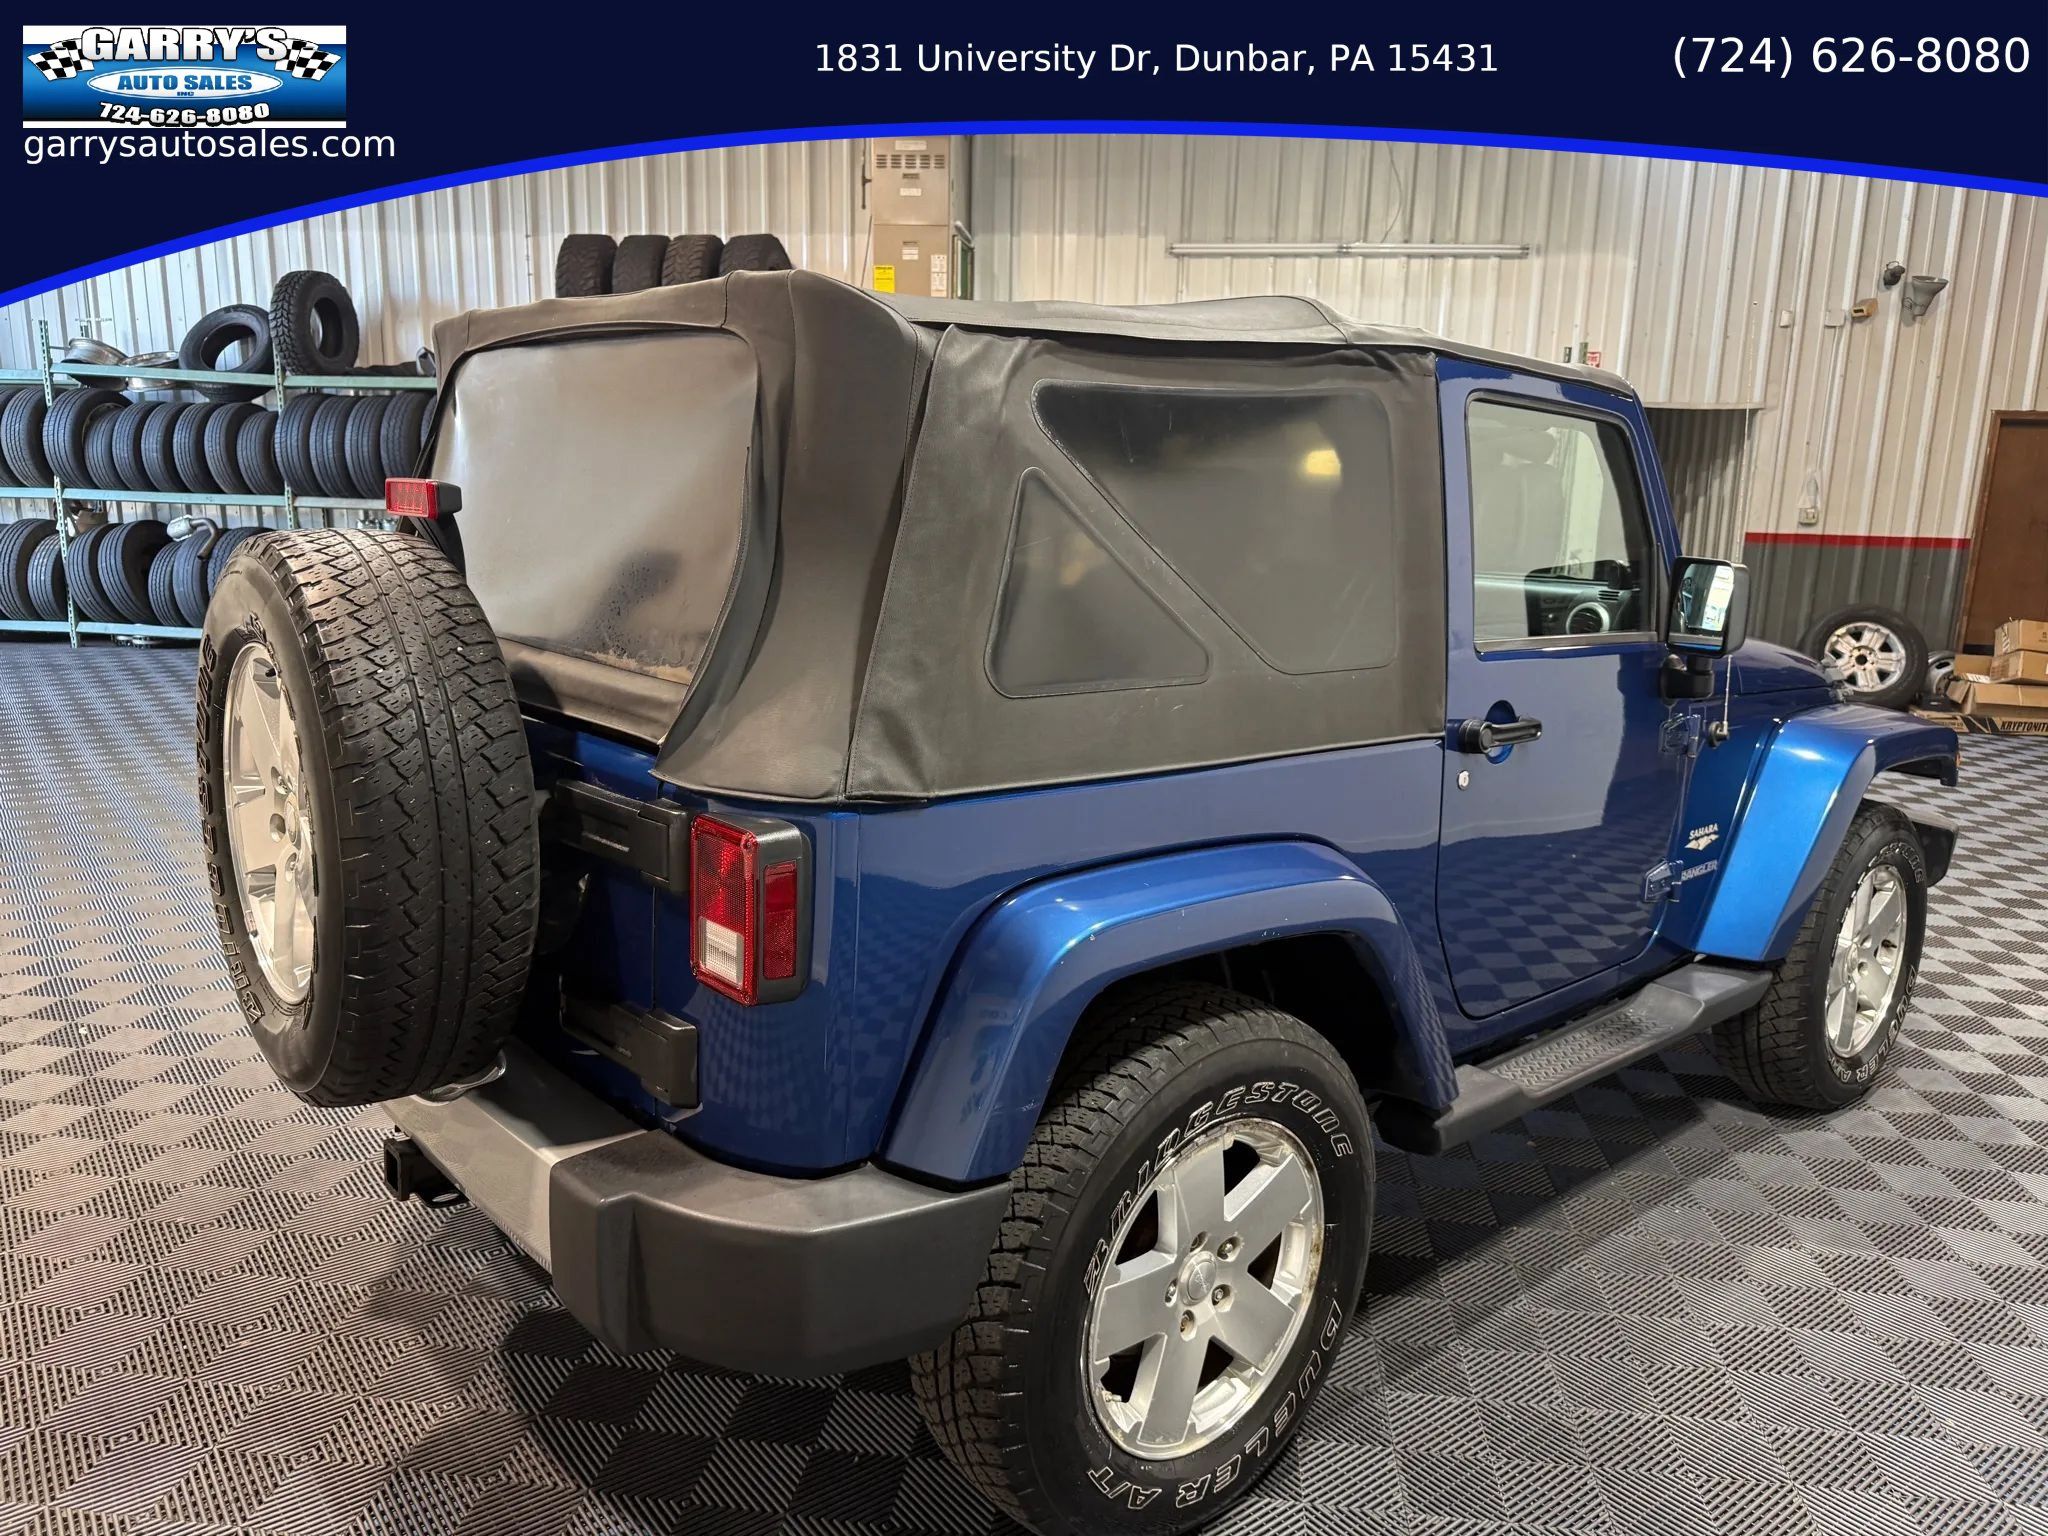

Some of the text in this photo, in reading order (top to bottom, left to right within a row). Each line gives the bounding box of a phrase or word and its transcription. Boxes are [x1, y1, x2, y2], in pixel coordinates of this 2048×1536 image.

[2000, 720, 2048, 733] KRYPTONIT
[1689, 823, 1719, 840] SAHARA
[1680, 859, 1718, 881] RANGLER
[1083, 1080, 1355, 1302] BRIDGESTONE
[1087, 1299, 1344, 1511] DUELER A/T
